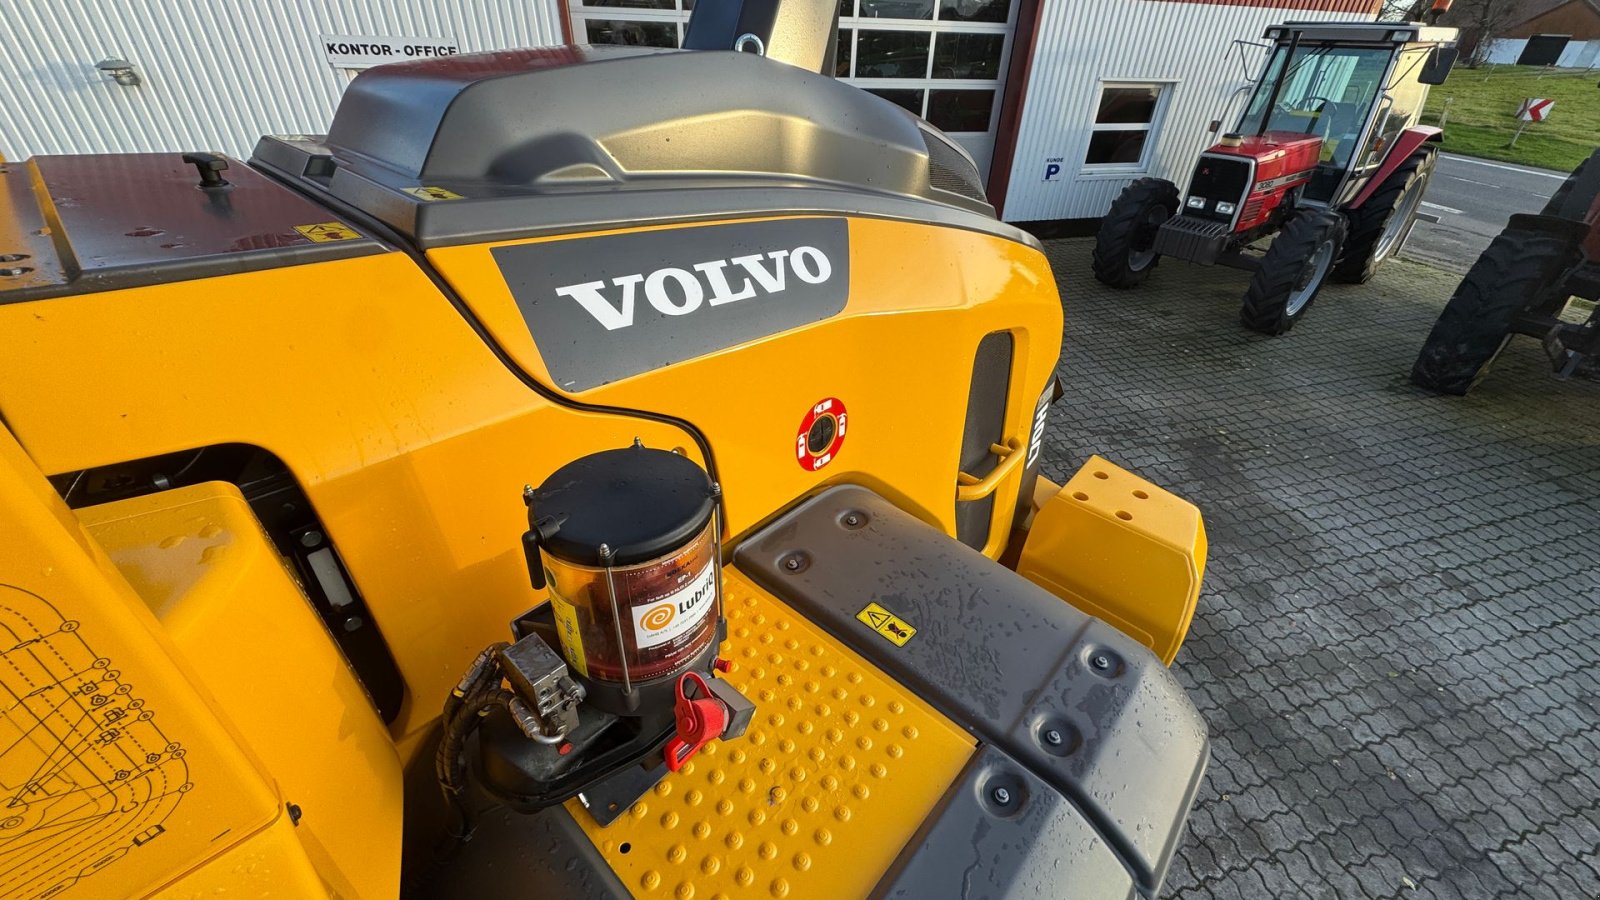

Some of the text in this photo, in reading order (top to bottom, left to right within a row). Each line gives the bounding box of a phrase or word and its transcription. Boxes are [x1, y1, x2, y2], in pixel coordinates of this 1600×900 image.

[326, 43, 393, 56] KONTOR
[403, 45, 457, 57] OFFICE
[1045, 164, 1060, 180] P
[555, 246, 832, 331] VOLVO
